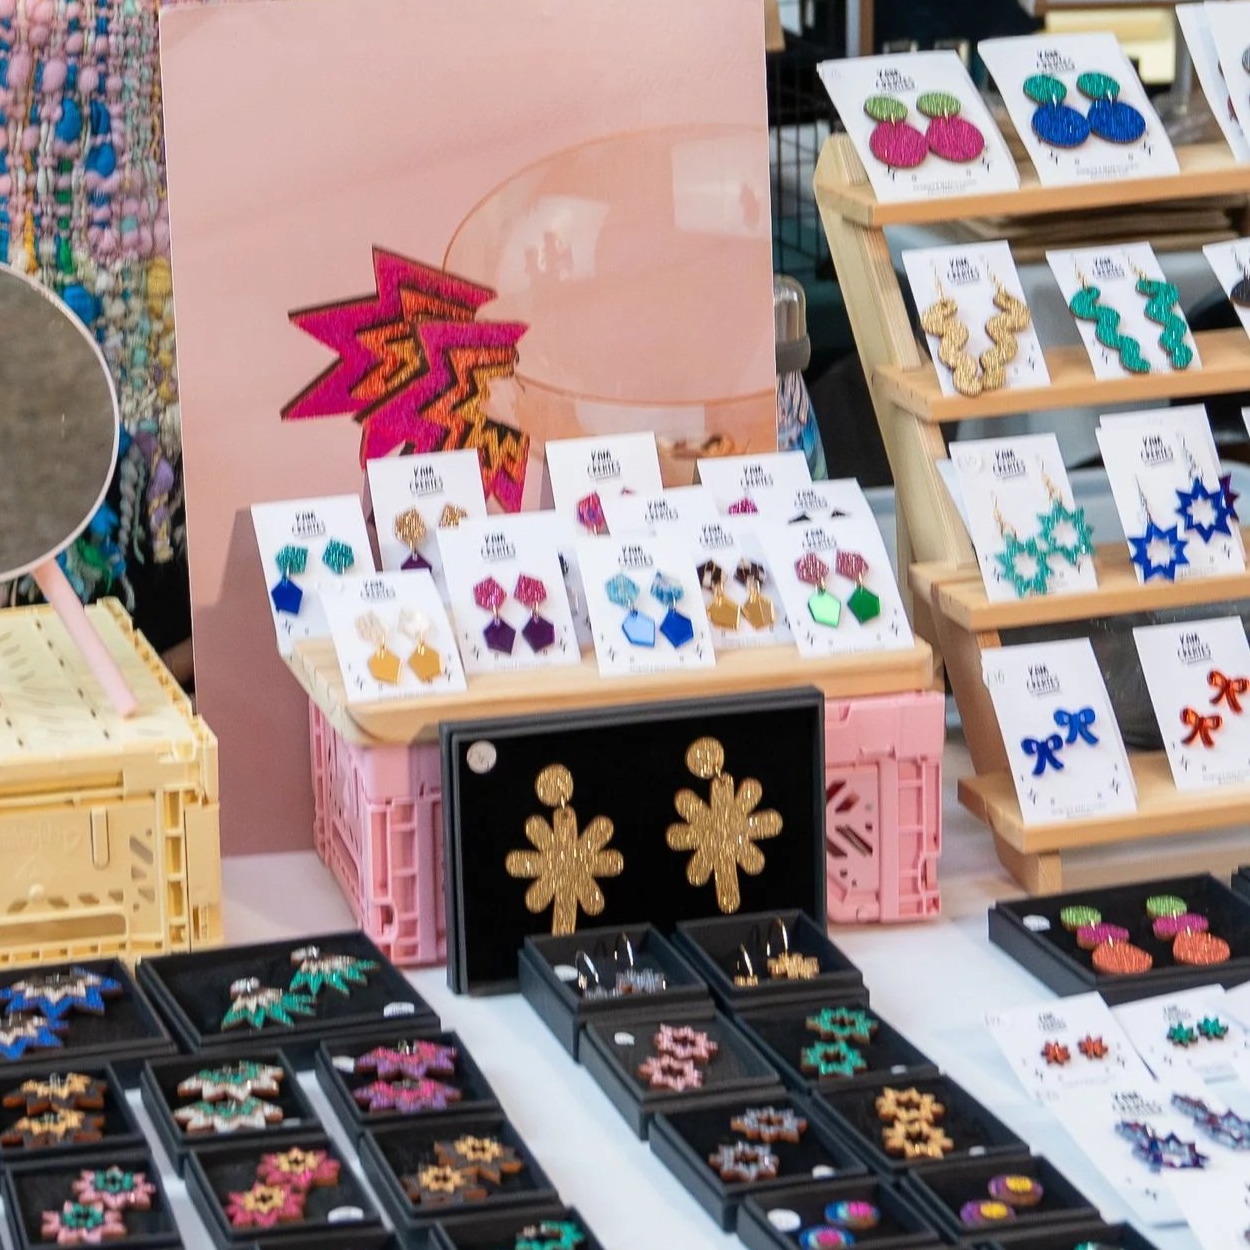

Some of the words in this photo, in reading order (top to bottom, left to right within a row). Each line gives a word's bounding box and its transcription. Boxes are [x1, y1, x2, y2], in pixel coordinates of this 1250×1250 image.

[1143, 435, 1163, 448] KAM
[591, 451, 612, 463] KAM
[995, 449, 1016, 461] KAM
[413, 465, 434, 478] KAM
[587, 462, 621, 477] CREATES
[743, 463, 763, 476] KAM
[993, 460, 1026, 475] CREATES
[410, 477, 443, 492] CREATES
[295, 511, 316, 523] KAM
[484, 533, 505, 545] KAM
[481, 544, 516, 559] CREATES
[1179, 632, 1200, 645] KAM
[1177, 644, 1212, 659] CREATES
[1027, 664, 1048, 677] KAM
[1026, 676, 1061, 693] CREATES
